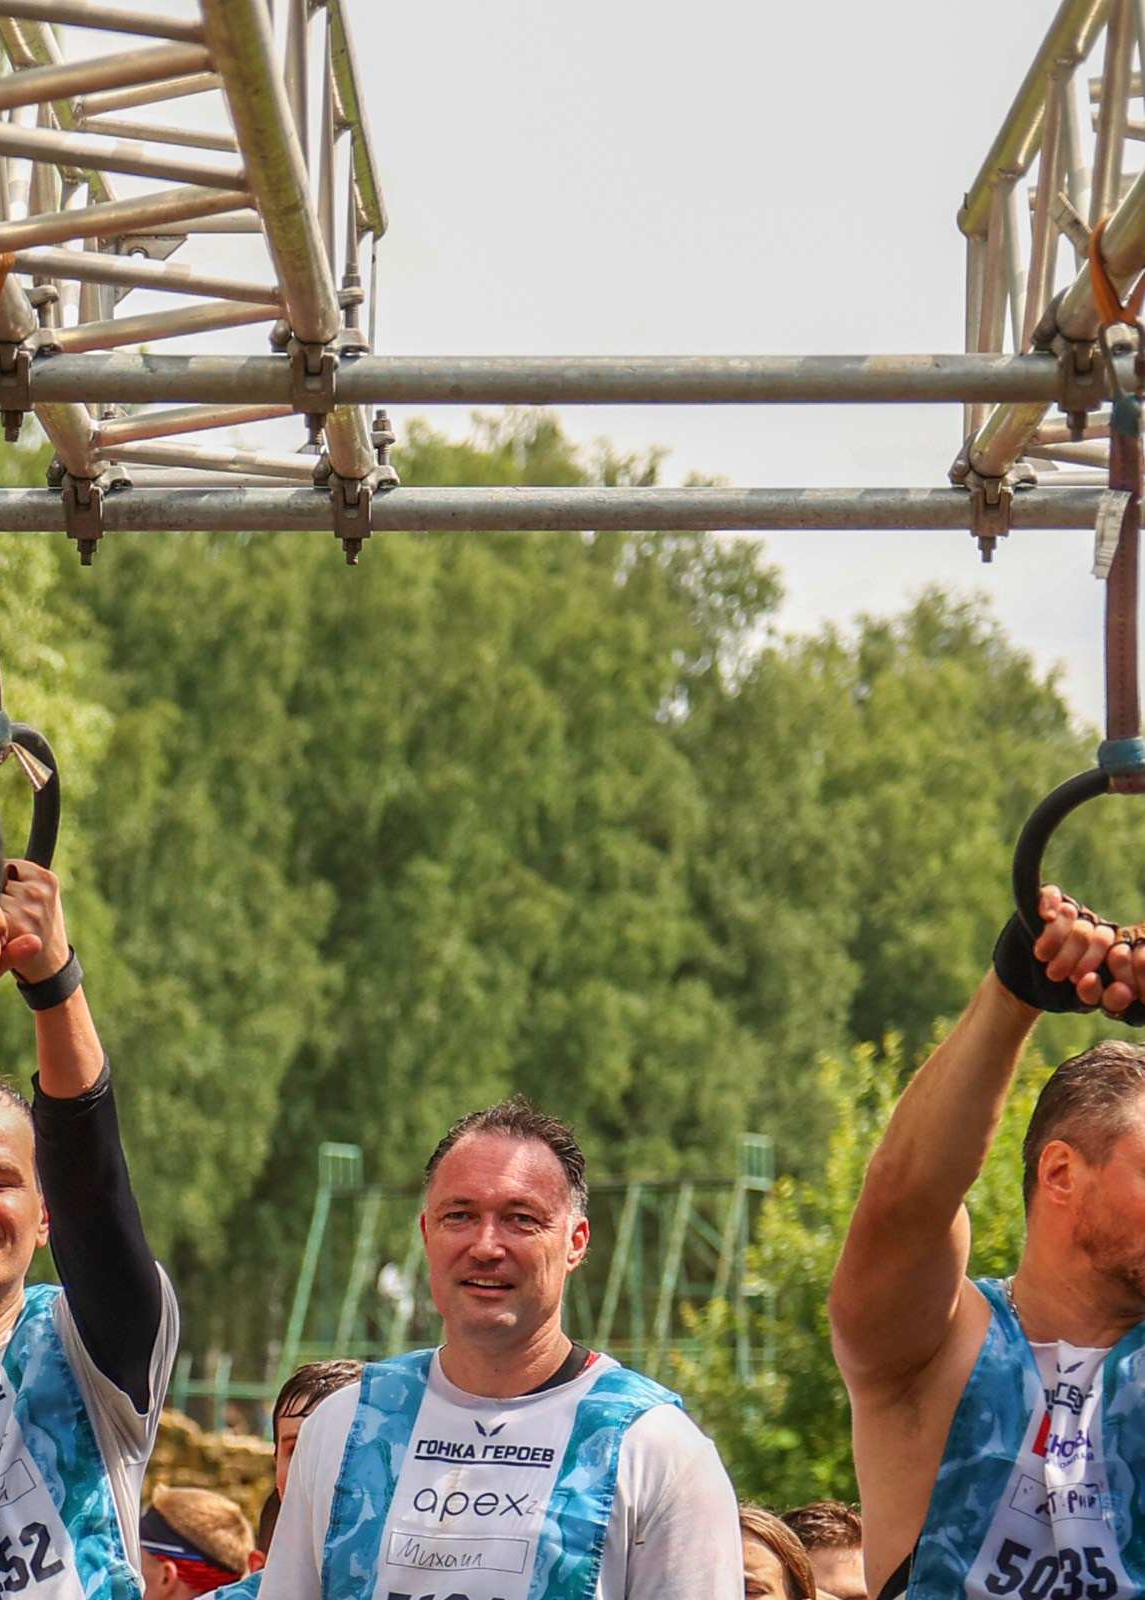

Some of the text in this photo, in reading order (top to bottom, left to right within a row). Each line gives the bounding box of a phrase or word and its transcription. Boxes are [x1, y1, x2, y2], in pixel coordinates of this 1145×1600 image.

[415, 1439, 555, 1463] ГОНКА ГЕРОЕВ
[413, 1487, 530, 1522] apex
[396, 1537, 482, 1568] Михаил
